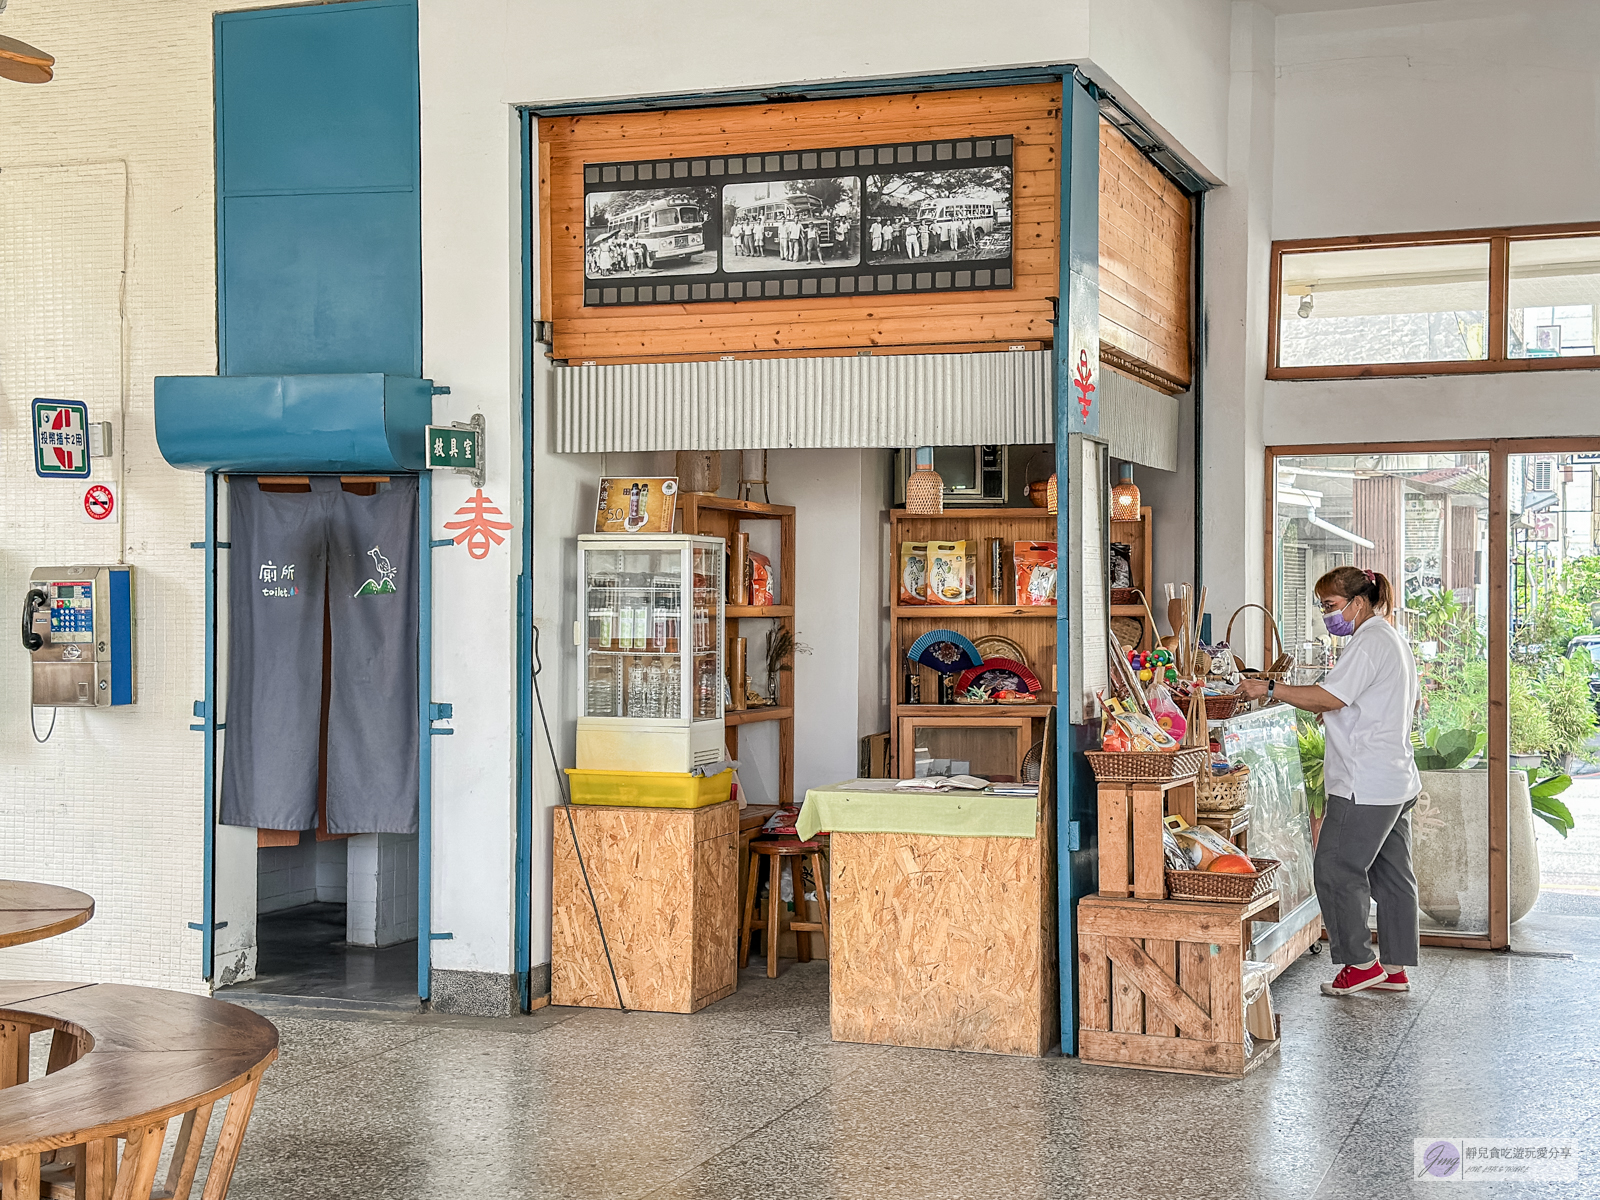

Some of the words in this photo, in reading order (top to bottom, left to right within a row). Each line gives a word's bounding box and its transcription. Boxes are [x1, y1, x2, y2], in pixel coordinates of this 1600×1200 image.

[40, 431, 83, 447] 投幣插卡2用
[443, 488, 514, 560] 春
[258, 560, 296, 583] 廁所
